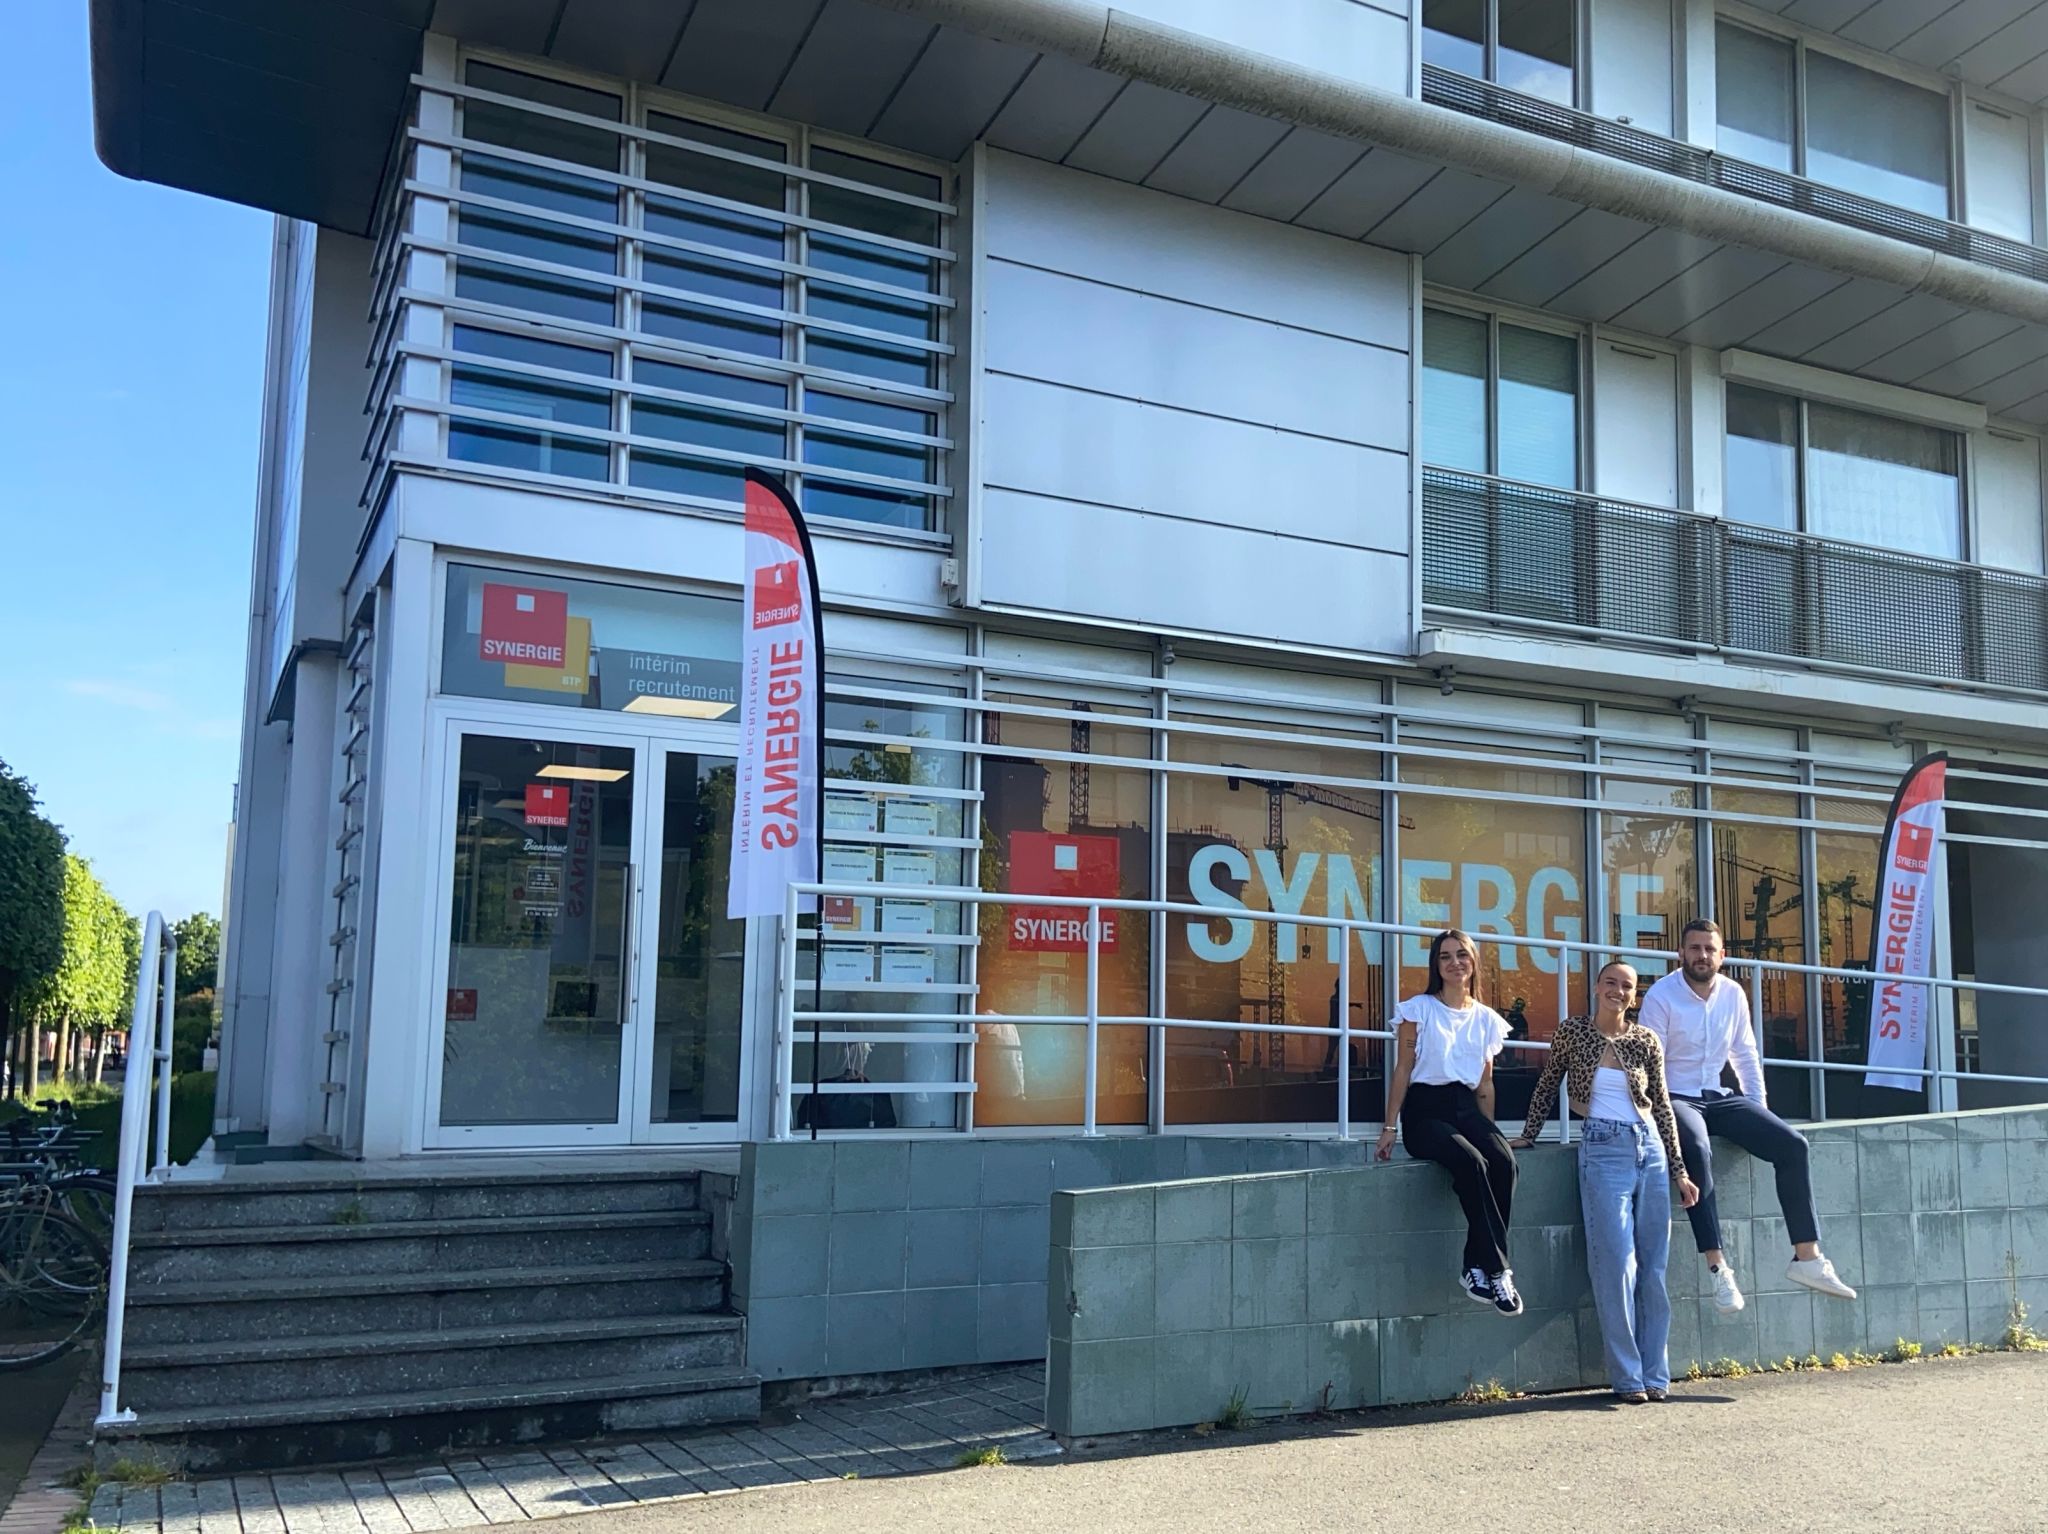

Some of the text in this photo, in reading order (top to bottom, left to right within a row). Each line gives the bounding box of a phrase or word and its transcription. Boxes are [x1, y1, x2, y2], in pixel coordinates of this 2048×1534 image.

[484, 639, 562, 662] SYNERGIE
[629, 653, 691, 676] intérim
[628, 677, 735, 702] recrutement
[526, 815, 568, 826] SYNERGIE
[1880, 881, 1916, 1040] SYNERGIE
